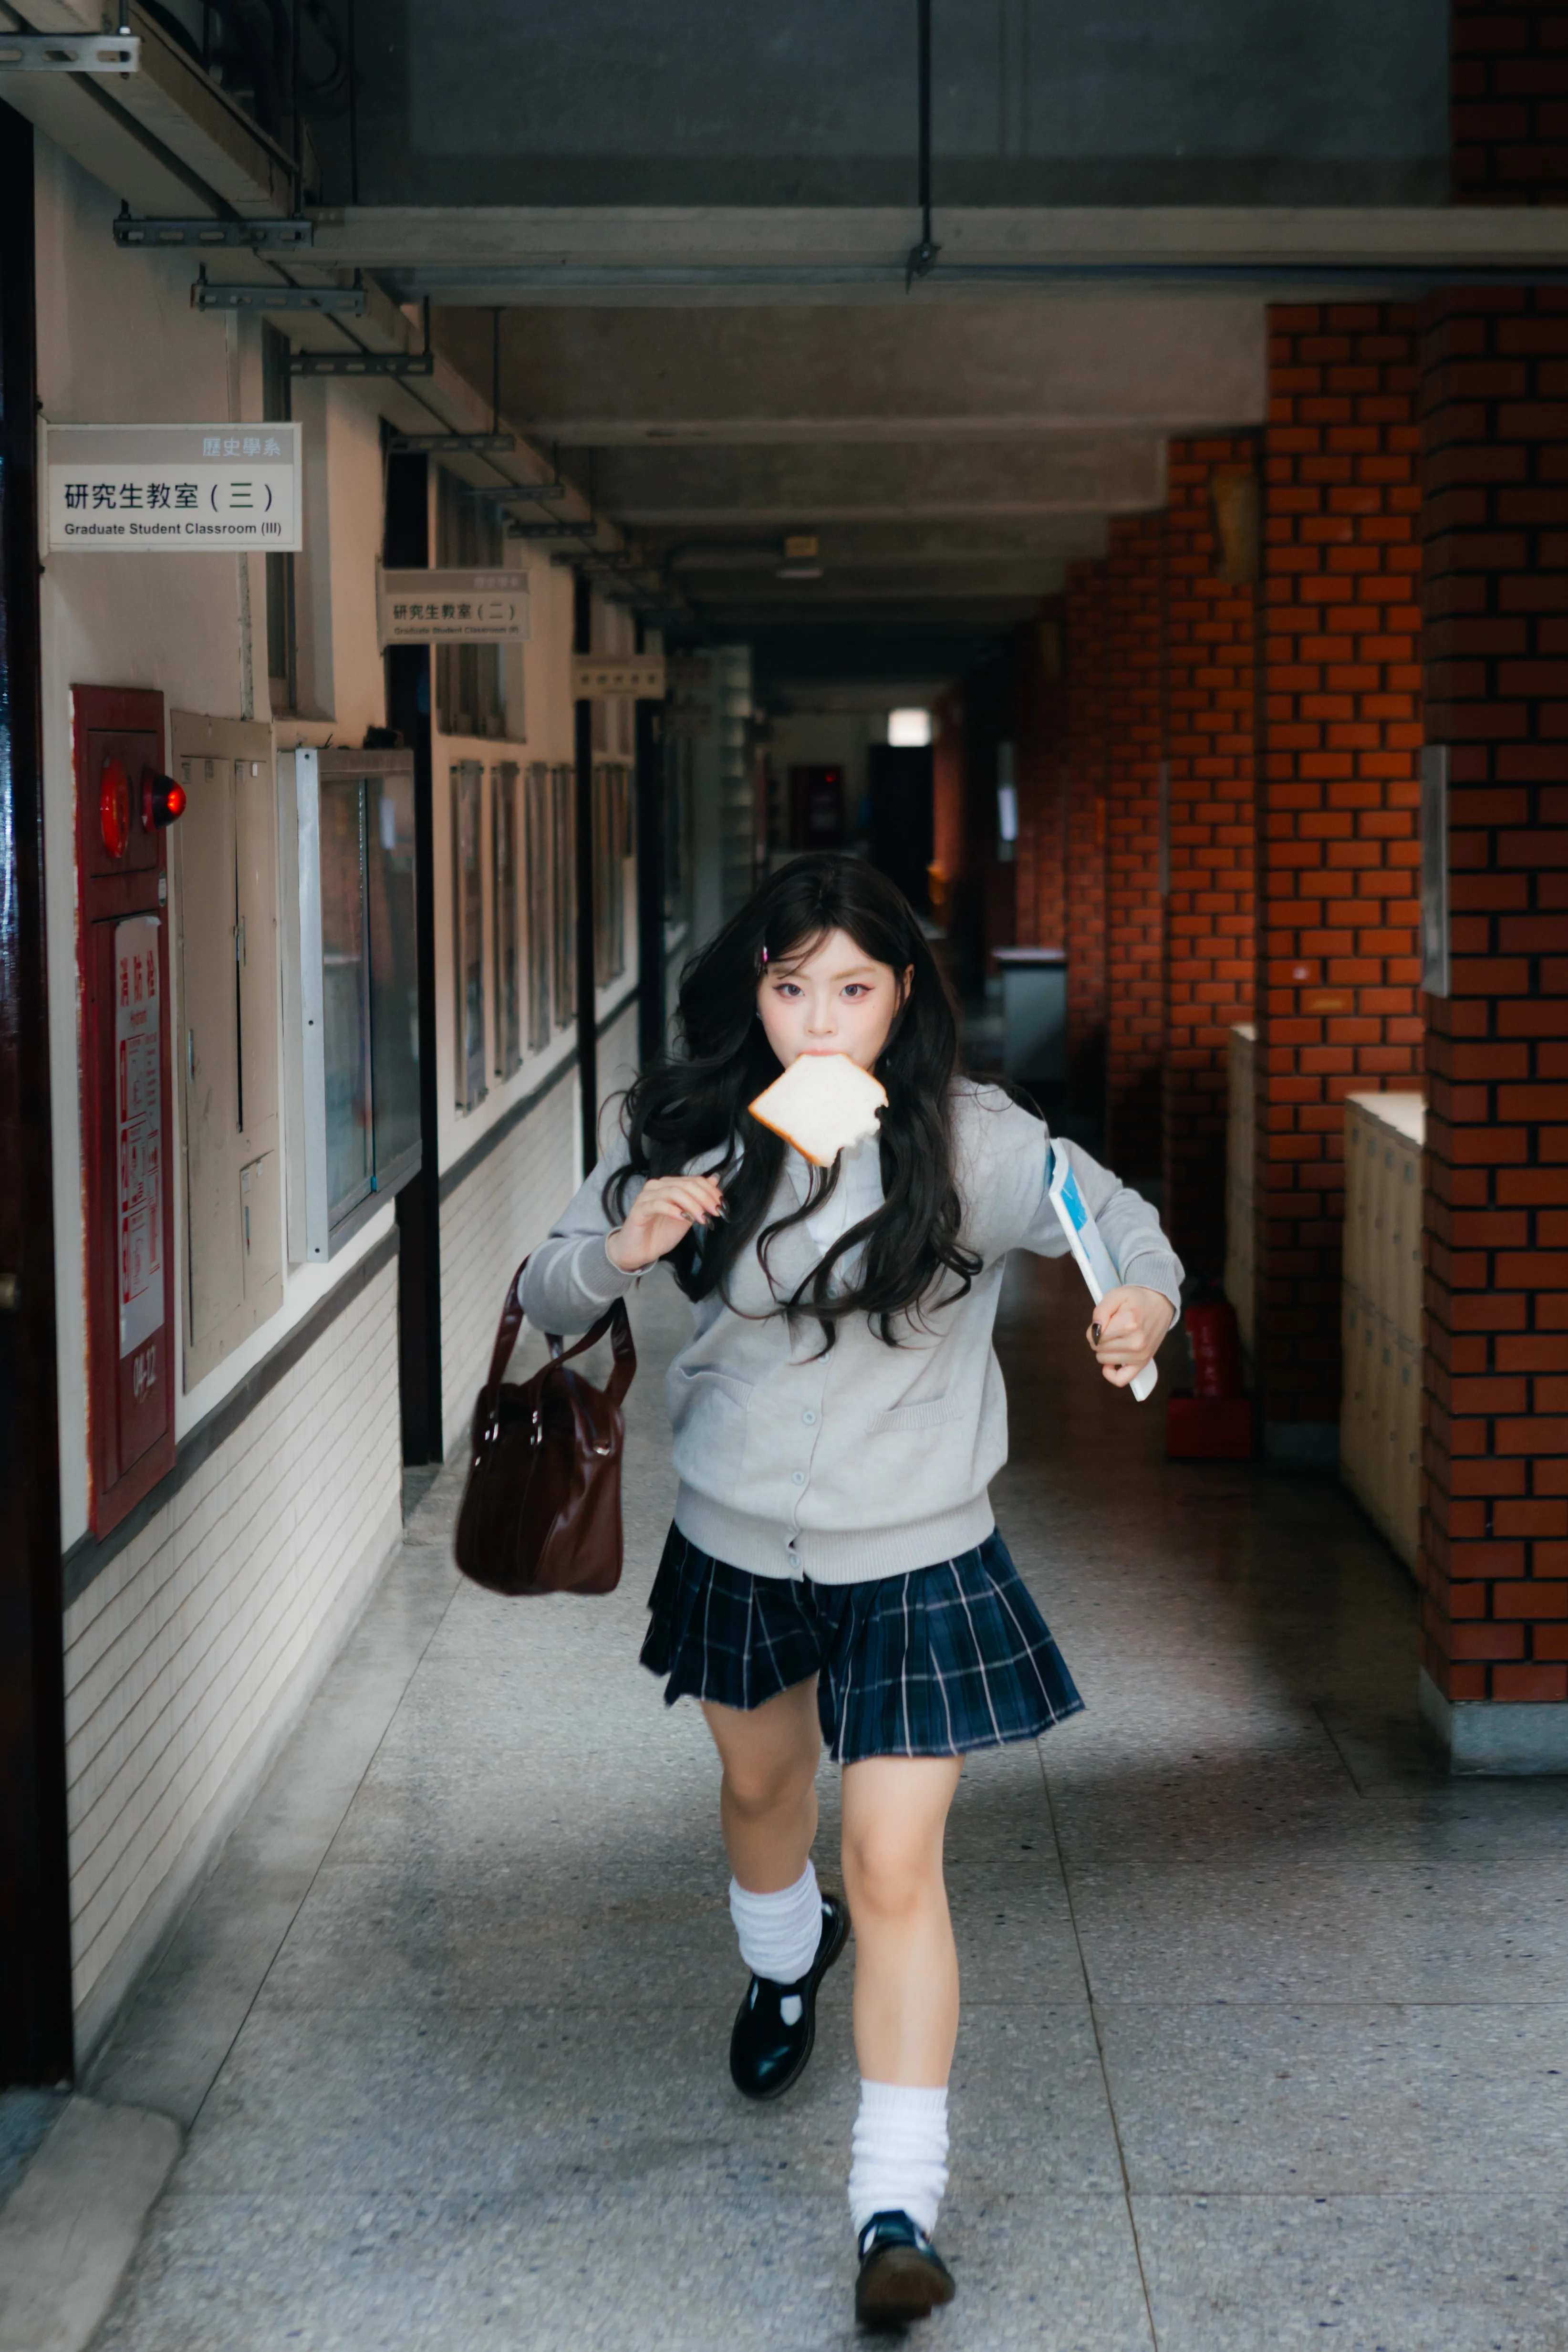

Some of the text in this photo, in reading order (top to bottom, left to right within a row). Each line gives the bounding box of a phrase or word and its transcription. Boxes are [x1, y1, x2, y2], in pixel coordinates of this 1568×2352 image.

[203, 437, 281, 457] 歷史學系
[64, 523, 281, 536] Graduate Student Classroom (III)
